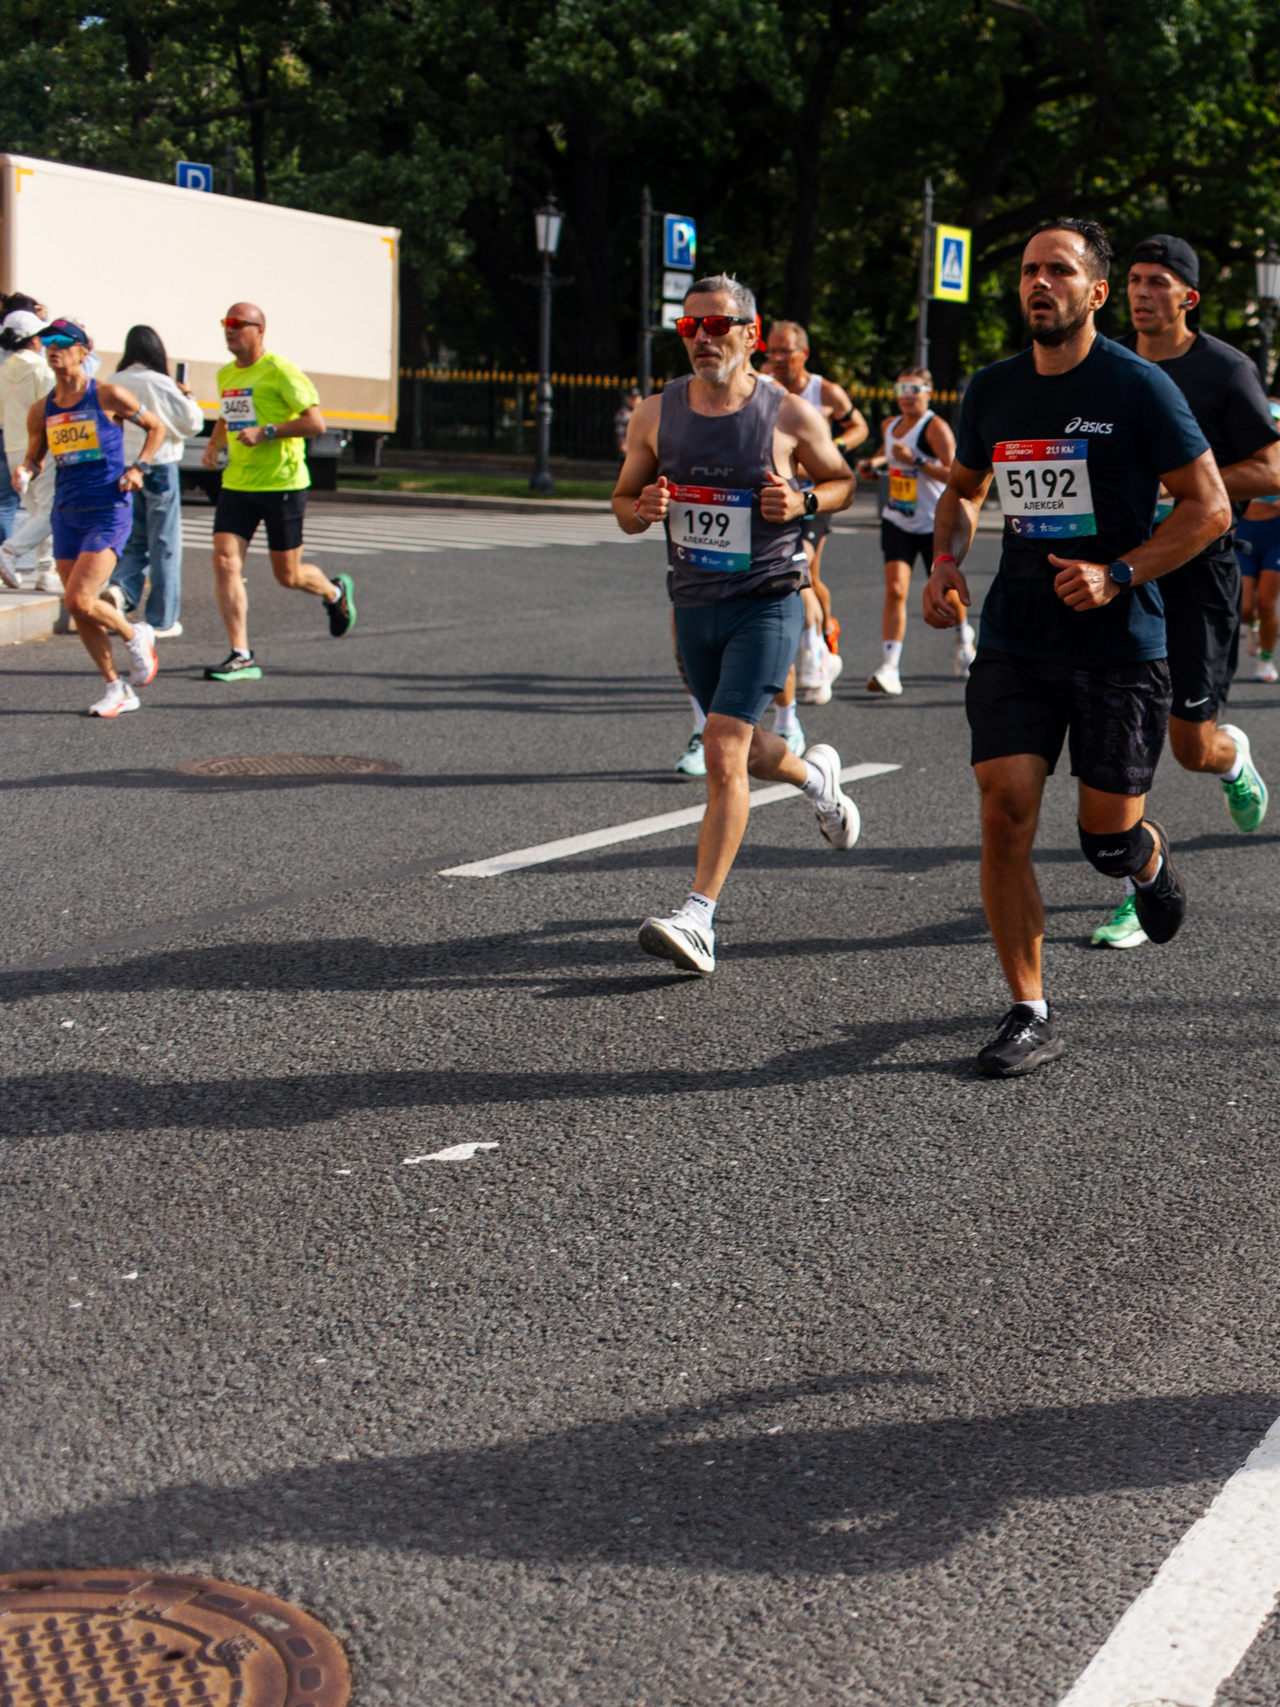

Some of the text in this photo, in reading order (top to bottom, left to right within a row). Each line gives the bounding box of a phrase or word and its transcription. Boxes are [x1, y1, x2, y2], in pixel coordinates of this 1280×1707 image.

[223, 400, 250, 414] 3405
[53, 426, 90, 445] 3804
[1006, 468, 1078, 499] 5192
[1023, 499, 1065, 511] АЛЕКСЕЙ
[684, 509, 730, 537] 199
[682, 535, 732, 549] АЛЕКСАНДР
